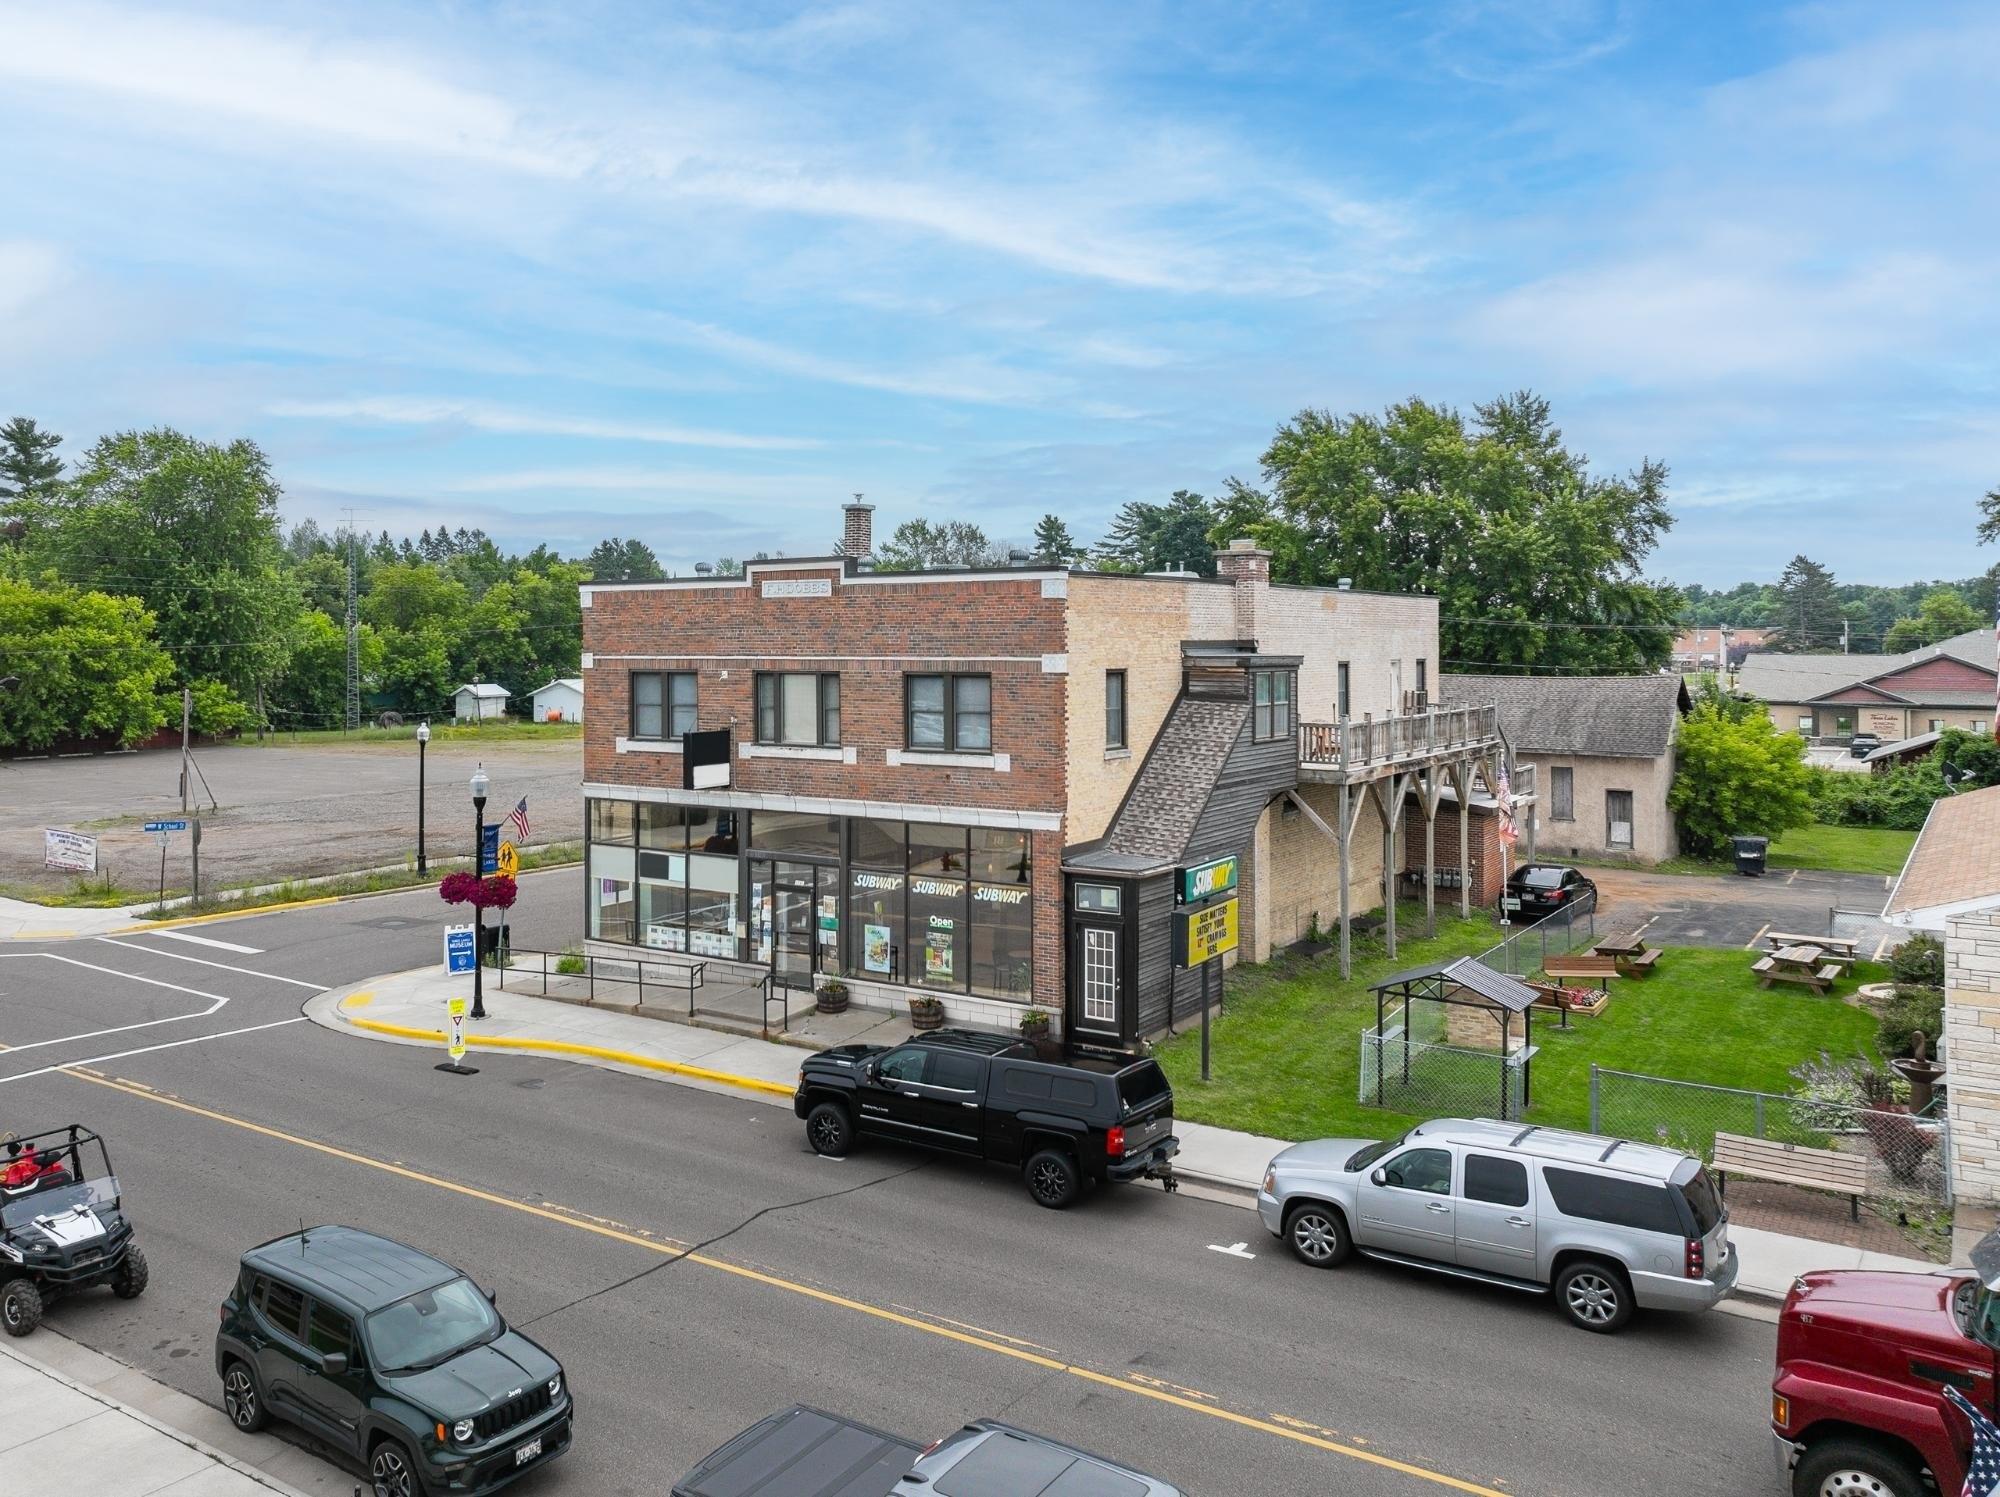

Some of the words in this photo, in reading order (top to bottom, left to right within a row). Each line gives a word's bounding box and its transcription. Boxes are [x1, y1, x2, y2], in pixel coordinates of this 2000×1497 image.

[854, 874, 902, 890] SUBWAY
[1193, 860, 1234, 897] SUBWAY
[912, 881, 963, 897] SUBWAY
[974, 887, 1027, 904] SUBWAY
[1210, 904, 1227, 920] MATTERS
[929, 915, 953, 928] Open
[1197, 923, 1212, 937] SATISFY
[1214, 917, 1224, 932] YOUR
[1207, 928, 1227, 944] CRAVINGS
[450, 941, 472, 949] MUSEUM
[508, 1387, 522, 1397] Jeep
